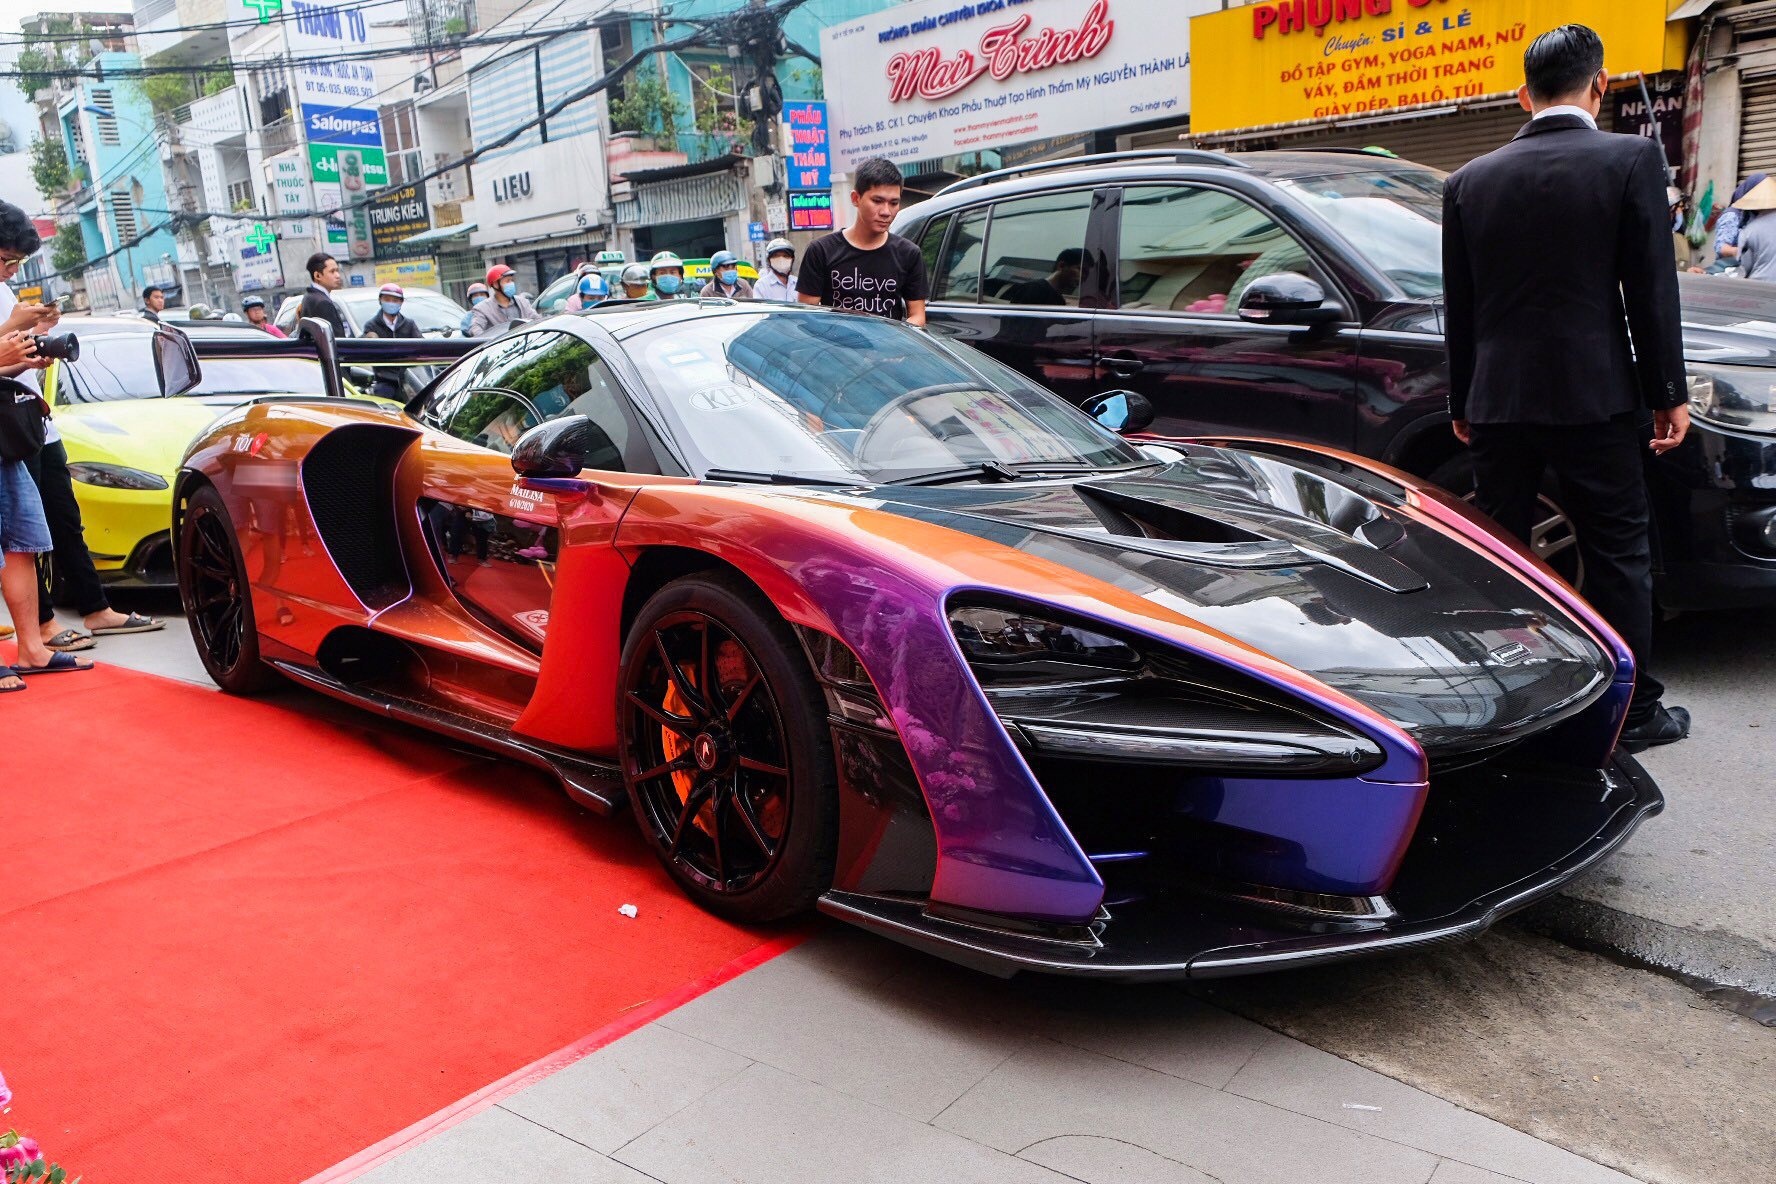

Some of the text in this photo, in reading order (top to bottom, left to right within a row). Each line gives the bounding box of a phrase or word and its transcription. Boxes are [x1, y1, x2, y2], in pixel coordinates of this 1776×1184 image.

[292, 1, 343, 39] THANH
[1414, 21, 1432, 36] &
[887, 0, 1114, 103] Mai Trinh
[1280, 62, 1304, 83] ĐỒ
[1341, 54, 1386, 73] GYM,
[1388, 45, 1437, 64] YOGA
[1440, 33, 1492, 56] NAM,
[1495, 22, 1527, 46] NỮ
[908, 111, 938, 125] Chuyên
[939, 106, 961, 118] Khoa
[1009, 91, 1025, 103] Tạo
[1026, 85, 1046, 100] Hình
[1139, 57, 1175, 76] THÀNH
[1303, 55, 1496, 100] VÁY, ĐẦM THỜI TRANG
[1453, 79, 1485, 99] TÚI
[493, 171, 532, 203] LIEU
[370, 206, 400, 225] TRUNG
[576, 214, 587, 227] 95
[831, 267, 897, 292] Believe
